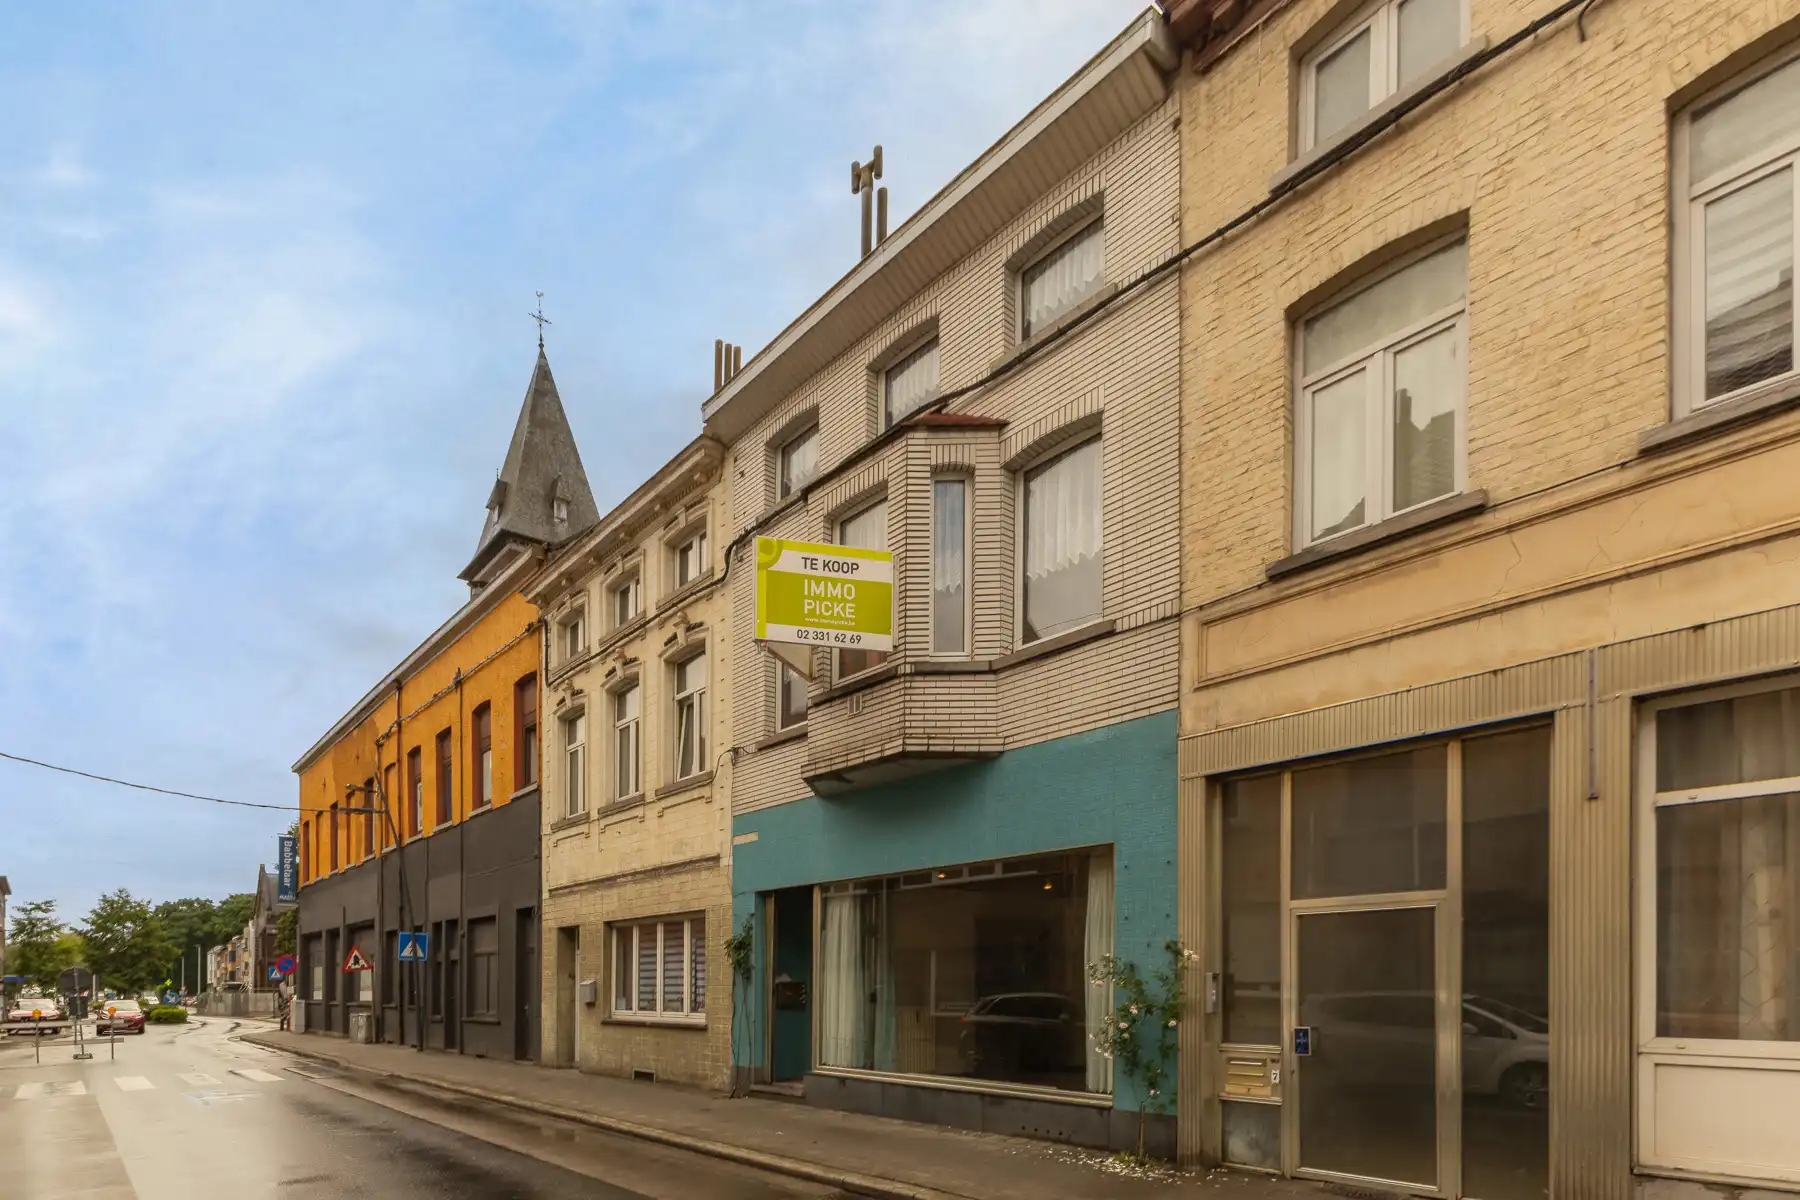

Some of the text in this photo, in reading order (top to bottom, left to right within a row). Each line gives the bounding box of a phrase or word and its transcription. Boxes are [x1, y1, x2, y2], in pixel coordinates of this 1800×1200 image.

[801, 556, 860, 575] TE KOOP
[803, 579, 856, 600] IMMO
[803, 599, 856, 619] PICKE
[796, 629, 862, 644] 02 331 62 69
[283, 840, 294, 887] Babbelaar
[1272, 1072, 1279, 1081] 7
